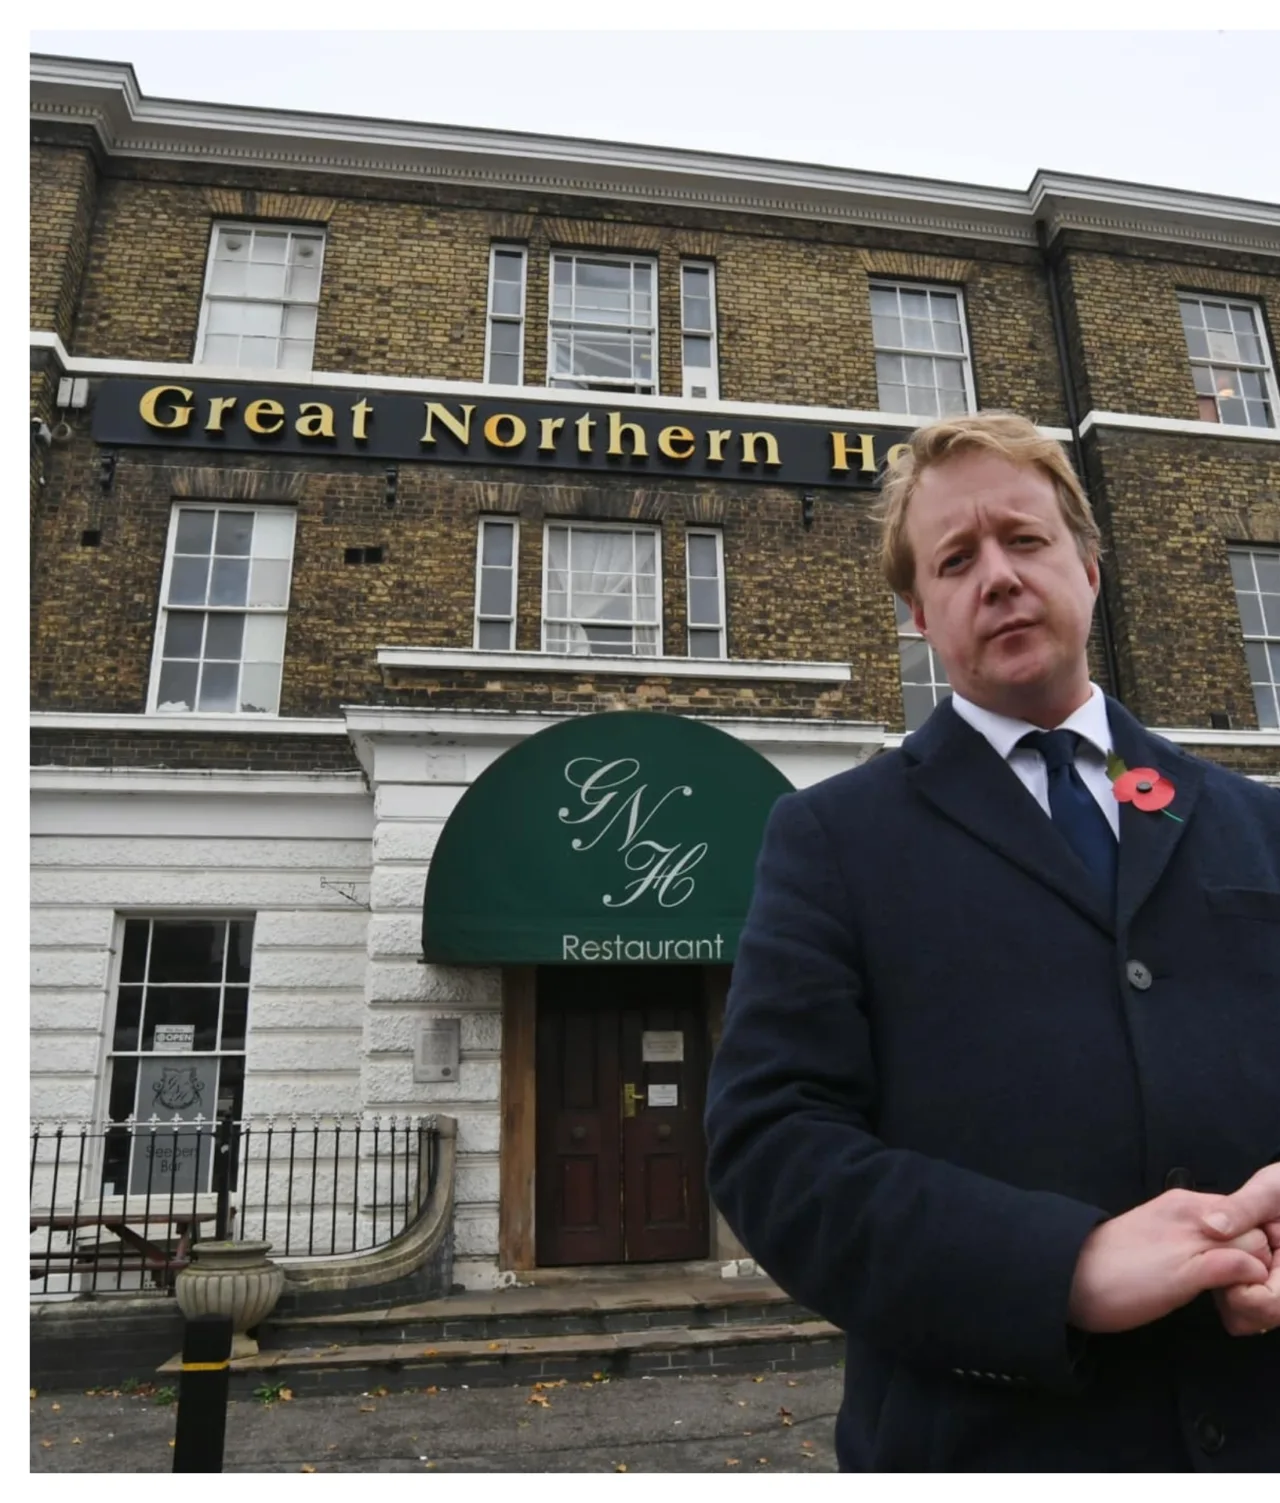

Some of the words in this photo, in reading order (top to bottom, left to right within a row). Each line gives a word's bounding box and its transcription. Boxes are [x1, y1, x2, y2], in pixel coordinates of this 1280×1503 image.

[138, 384, 375, 440] Great
[420, 402, 783, 467] Northern
[562, 933, 725, 961] Restaurant
[166, 1033, 191, 1042] OPEN
